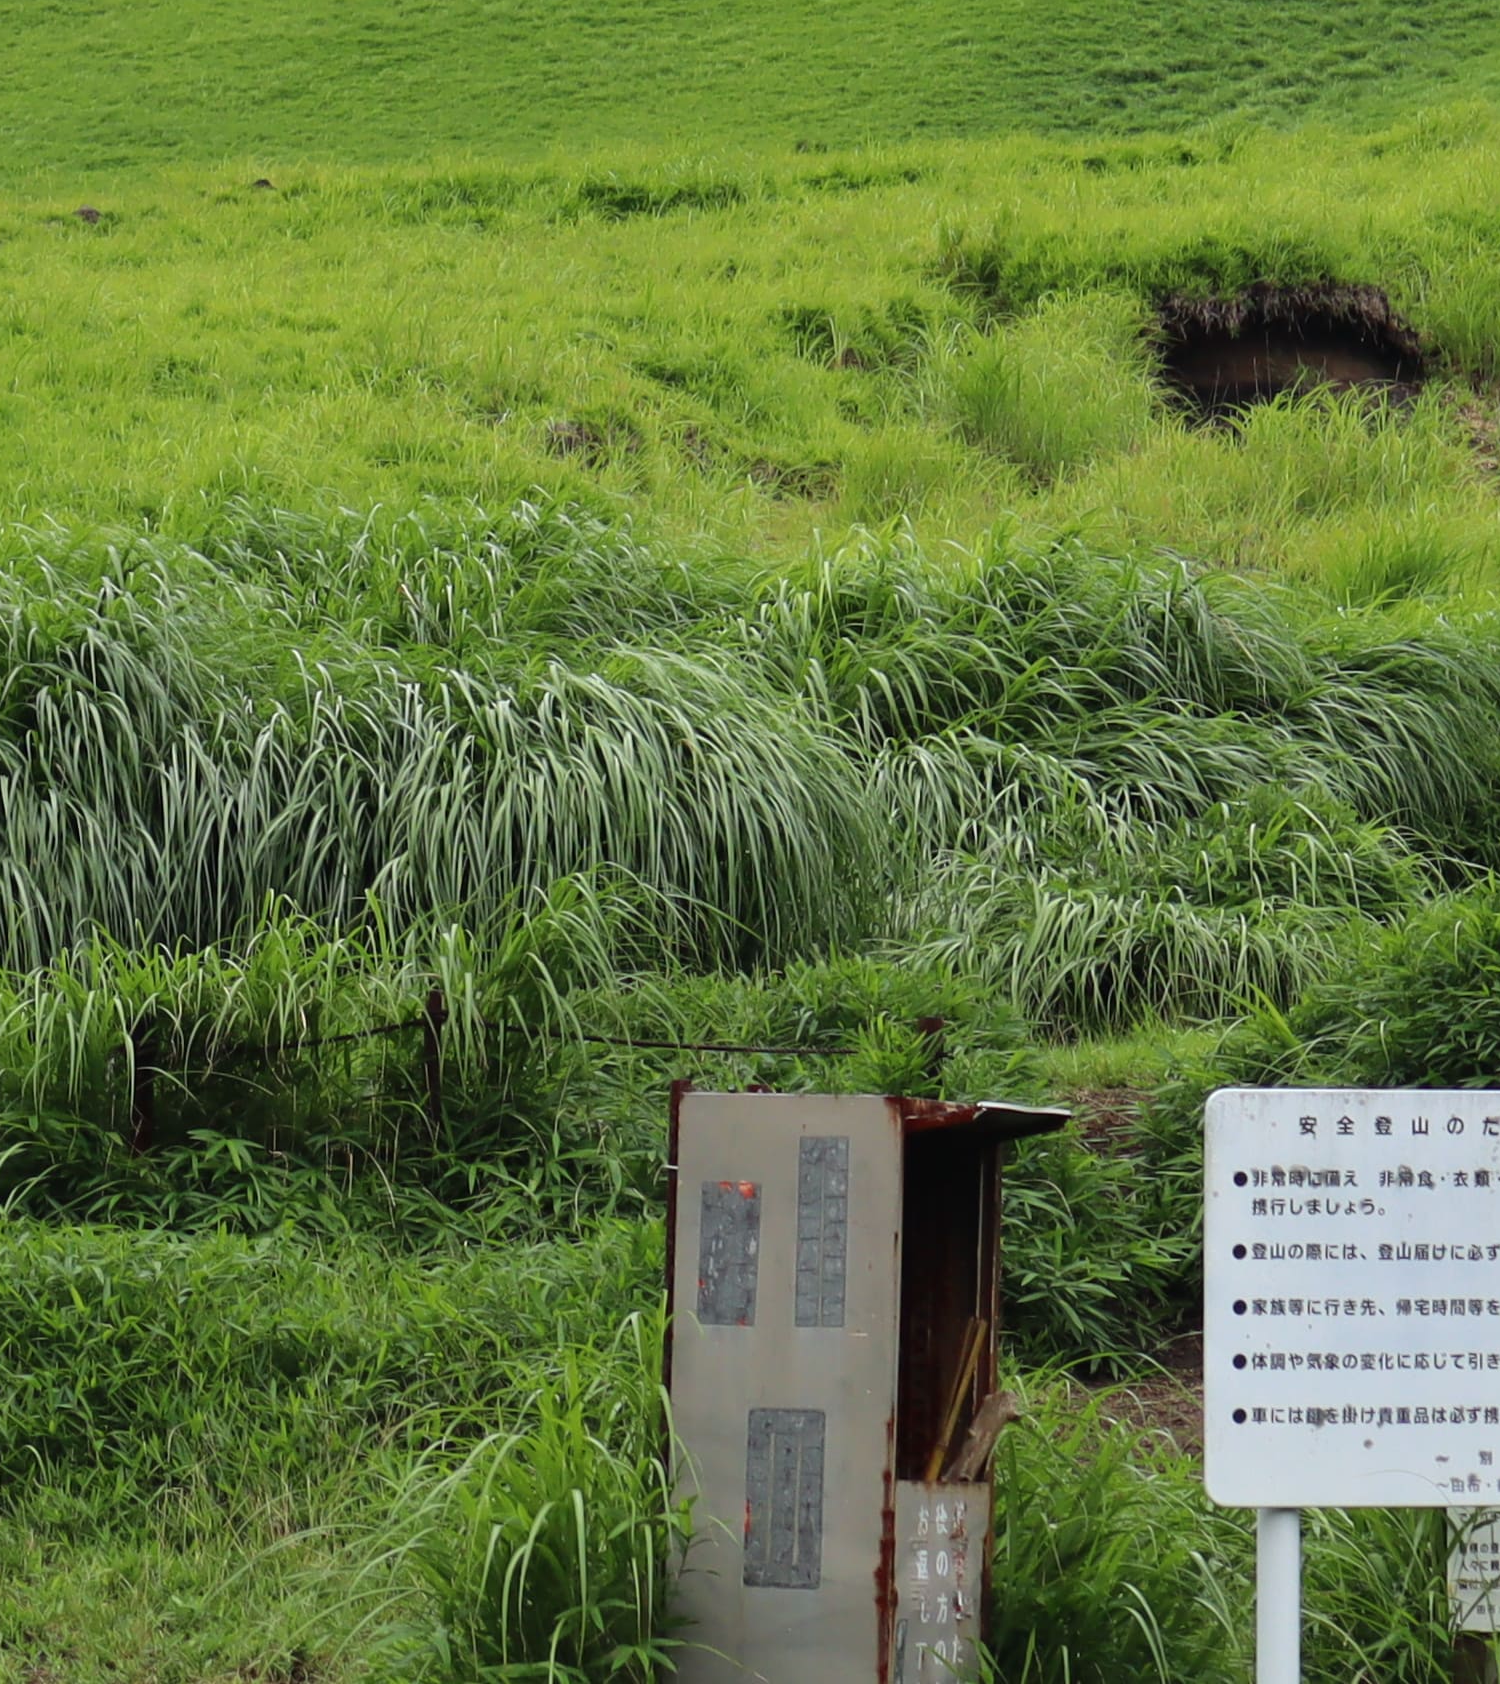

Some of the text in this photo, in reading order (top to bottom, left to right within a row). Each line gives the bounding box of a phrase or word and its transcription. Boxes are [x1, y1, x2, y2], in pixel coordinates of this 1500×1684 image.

[1251, 1198, 1386, 1216] 携行しましょう。
